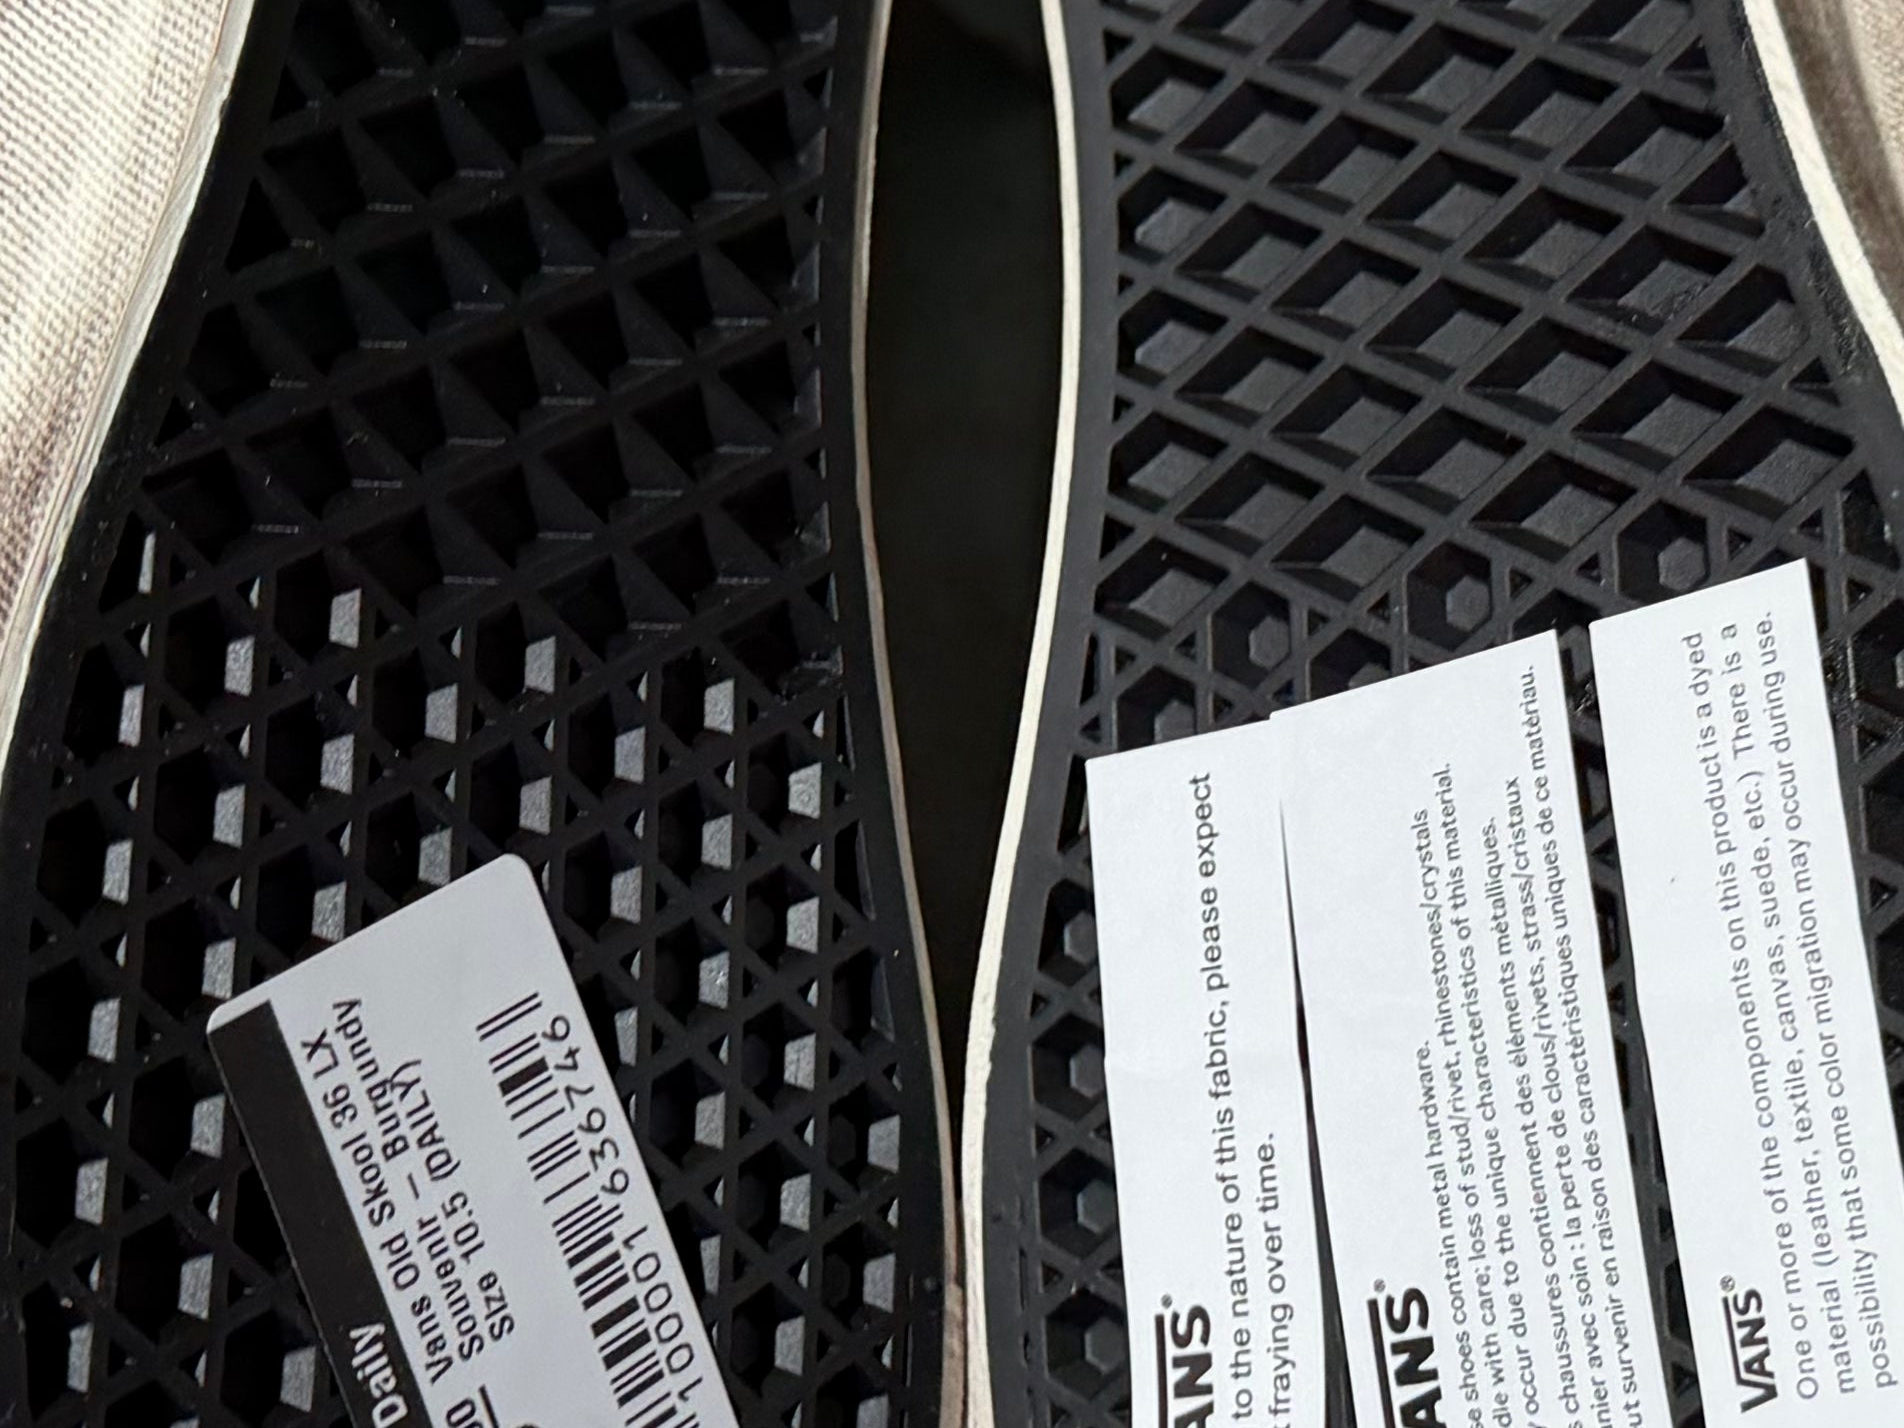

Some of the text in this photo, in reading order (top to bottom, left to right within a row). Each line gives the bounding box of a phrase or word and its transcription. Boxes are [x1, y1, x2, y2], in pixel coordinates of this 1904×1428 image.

[1517, 663, 1548, 773] matériau.
[1187, 770, 1222, 880] expect
[1430, 761, 1463, 864] material.
[1532, 773, 1552, 804] ce
[1532, 804, 1557, 837] de
[1443, 863, 1470, 914] this
[1480, 815, 1514, 958] métalliques.
[1504, 774, 1544, 954] strass/cristaux
[1540, 837, 1570, 932] uniques
[1198, 885, 1232, 994] please
[1409, 807, 1459, 1049] rhinestones/crystals
[1447, 914, 1474, 943] of
[1456, 943, 1498, 1124] characteristics
[1496, 958, 1530, 1070] éléments
[1526, 954, 1564, 1106] clous/rivets,
[1554, 932, 1597, 1127] caractéristiques
[1679, 631, 1821, 1401] One or more of the components on this product is a dyed
[1719, 622, 1858, 1396] material (leather, textile, canvas, suede, etc.) There is a
[1755, 610, 1900, 1390] possibility that some color migration may occur during use.
[331, 997, 420, 1165] Burgundy
[1202, 999, 1234, 1103] fabric,
[539, 1013, 631, 1198] 636746
[1210, 1105, 1239, 1168] this
[1415, 1038, 1445, 1160] hardware.
[1441, 1049, 1477, 1179] stud/rivet,
[1512, 1071, 1536, 1118] des
[1544, 1107, 1570, 1141] de
[1213, 1170, 1242, 1206] of
[1253, 1131, 1281, 1216] time.
[1483, 1125, 1510, 1210] unique
[1552, 1142, 1585, 1213] perte
[1579, 1127, 1604, 1174] des
[299, 1026, 455, 1387] Vans Old Skool 36 LX
[390, 1058, 516, 1344] Size 10.5 (DAILY)
[1425, 1160, 1455, 1231] metal
[1455, 1181, 1481, 1210] of
[1492, 1212, 1517, 1258] the
[1518, 1118, 1559, 1270] contiennent
[1560, 1214, 1584, 1241] la
[1589, 1175, 1617, 1254] raison
[1223, 1211, 1251, 1320] nature
[1262, 1218, 1288, 1296] over
[1437, 1232, 1469, 1327] contain
[1465, 1210, 1489, 1264] loss
[1501, 1258, 1522, 1290] to
[1601, 1255, 1622, 1289] en
[1473, 1263, 1498, 1329] care;
[1505, 1290, 1529, 1340] due
[1227, 1326, 1254, 1382] the
[1265, 1301, 1298, 1419] fraying
[1454, 1328, 1481, 1404] shoes
[1479, 1330, 1507, 1389] with
[1513, 1343, 1541, 1418] occur
[1543, 1271, 1582, 1417] chaussures
[1579, 1311, 1605, 1371] avec
[1603, 1291, 1639, 1396] survenir
[1229, 1386, 1255, 1423] to
